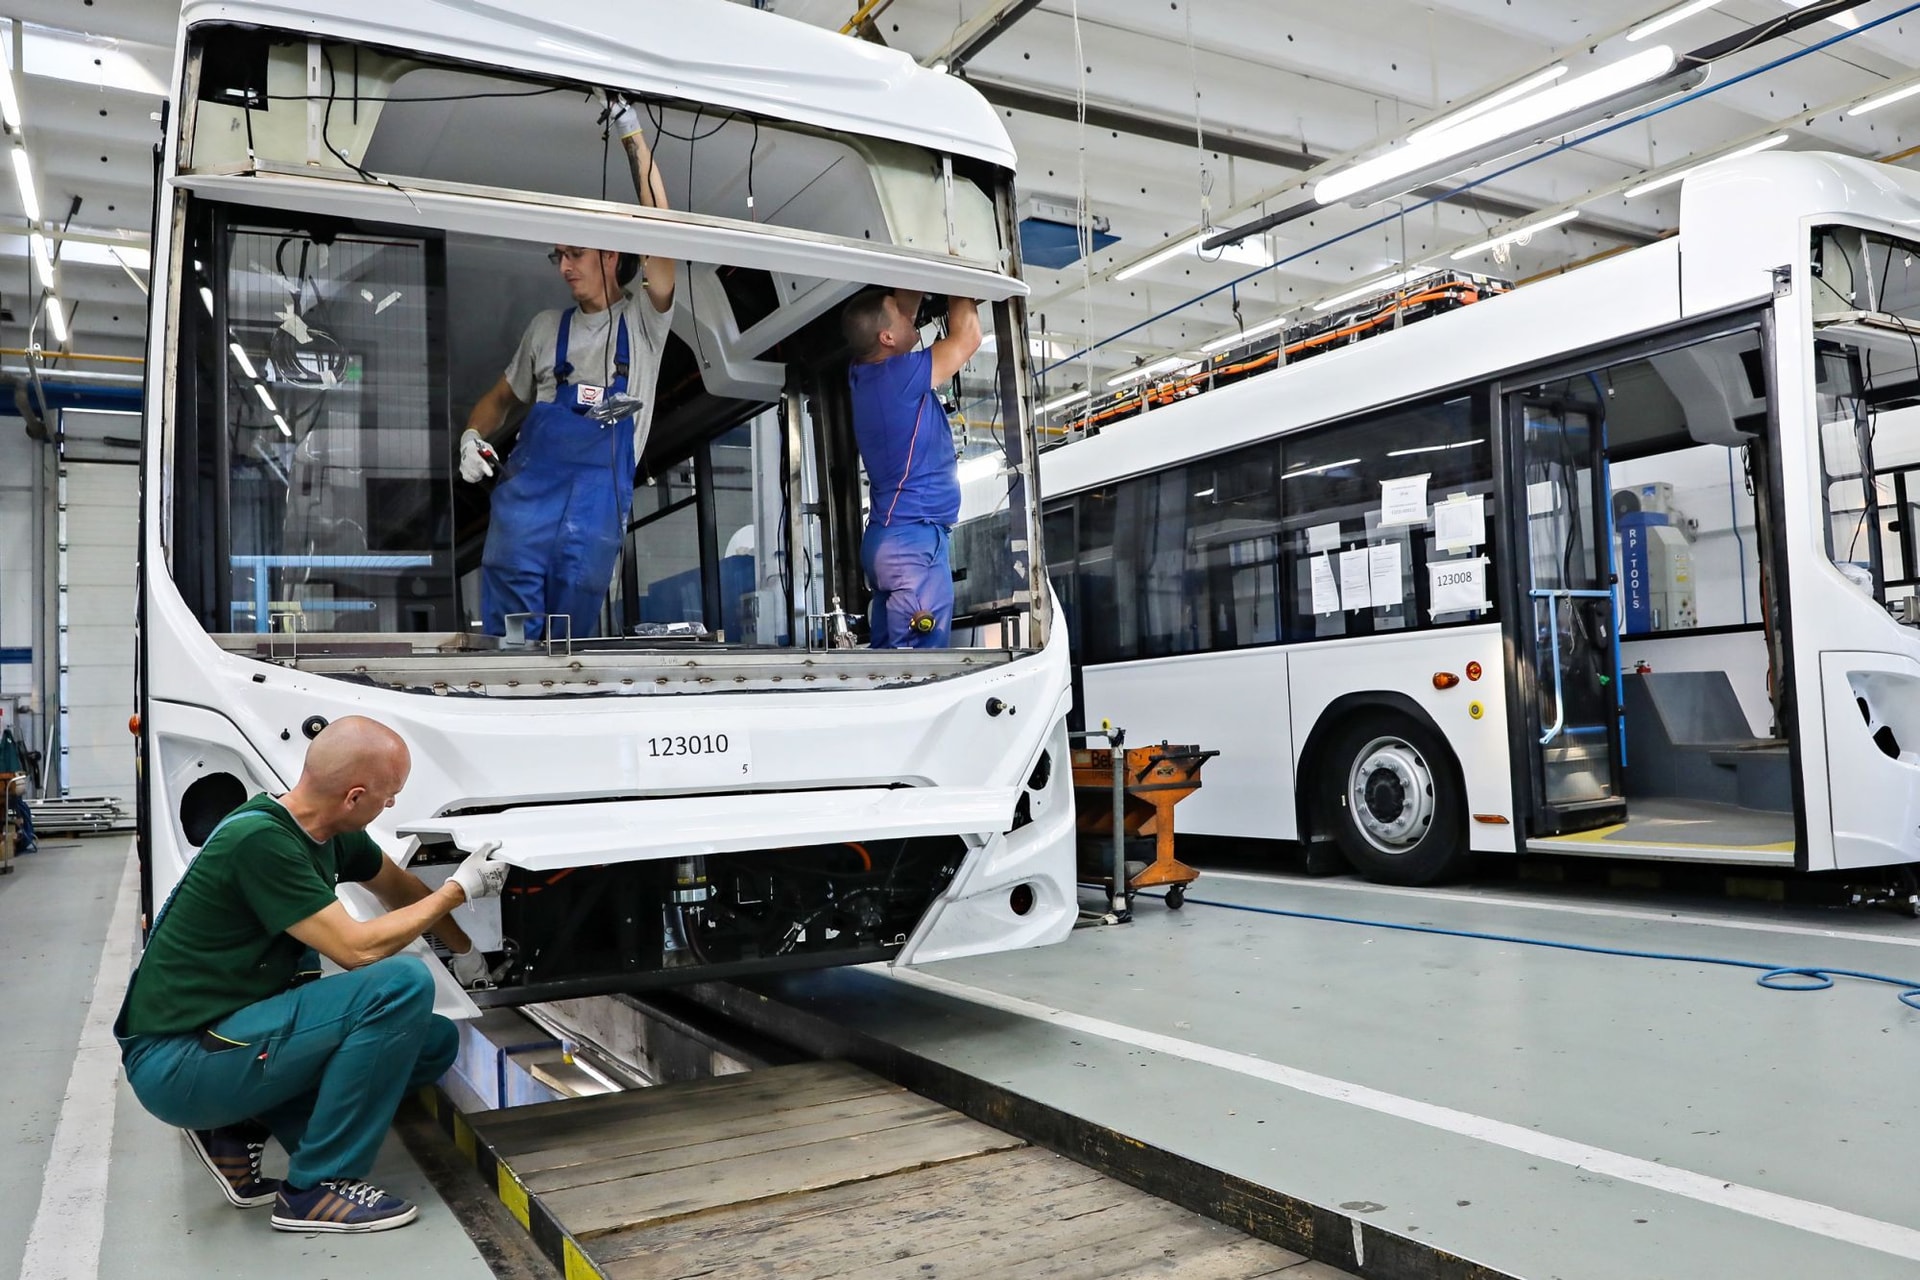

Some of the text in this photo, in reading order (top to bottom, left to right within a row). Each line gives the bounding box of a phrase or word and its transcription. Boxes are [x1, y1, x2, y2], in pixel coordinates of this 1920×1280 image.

[1437, 571, 1472, 587] 123008
[648, 733, 729, 757] 123010
[1091, 751, 1114, 768] Bet
[741, 763, 749, 774] 5
